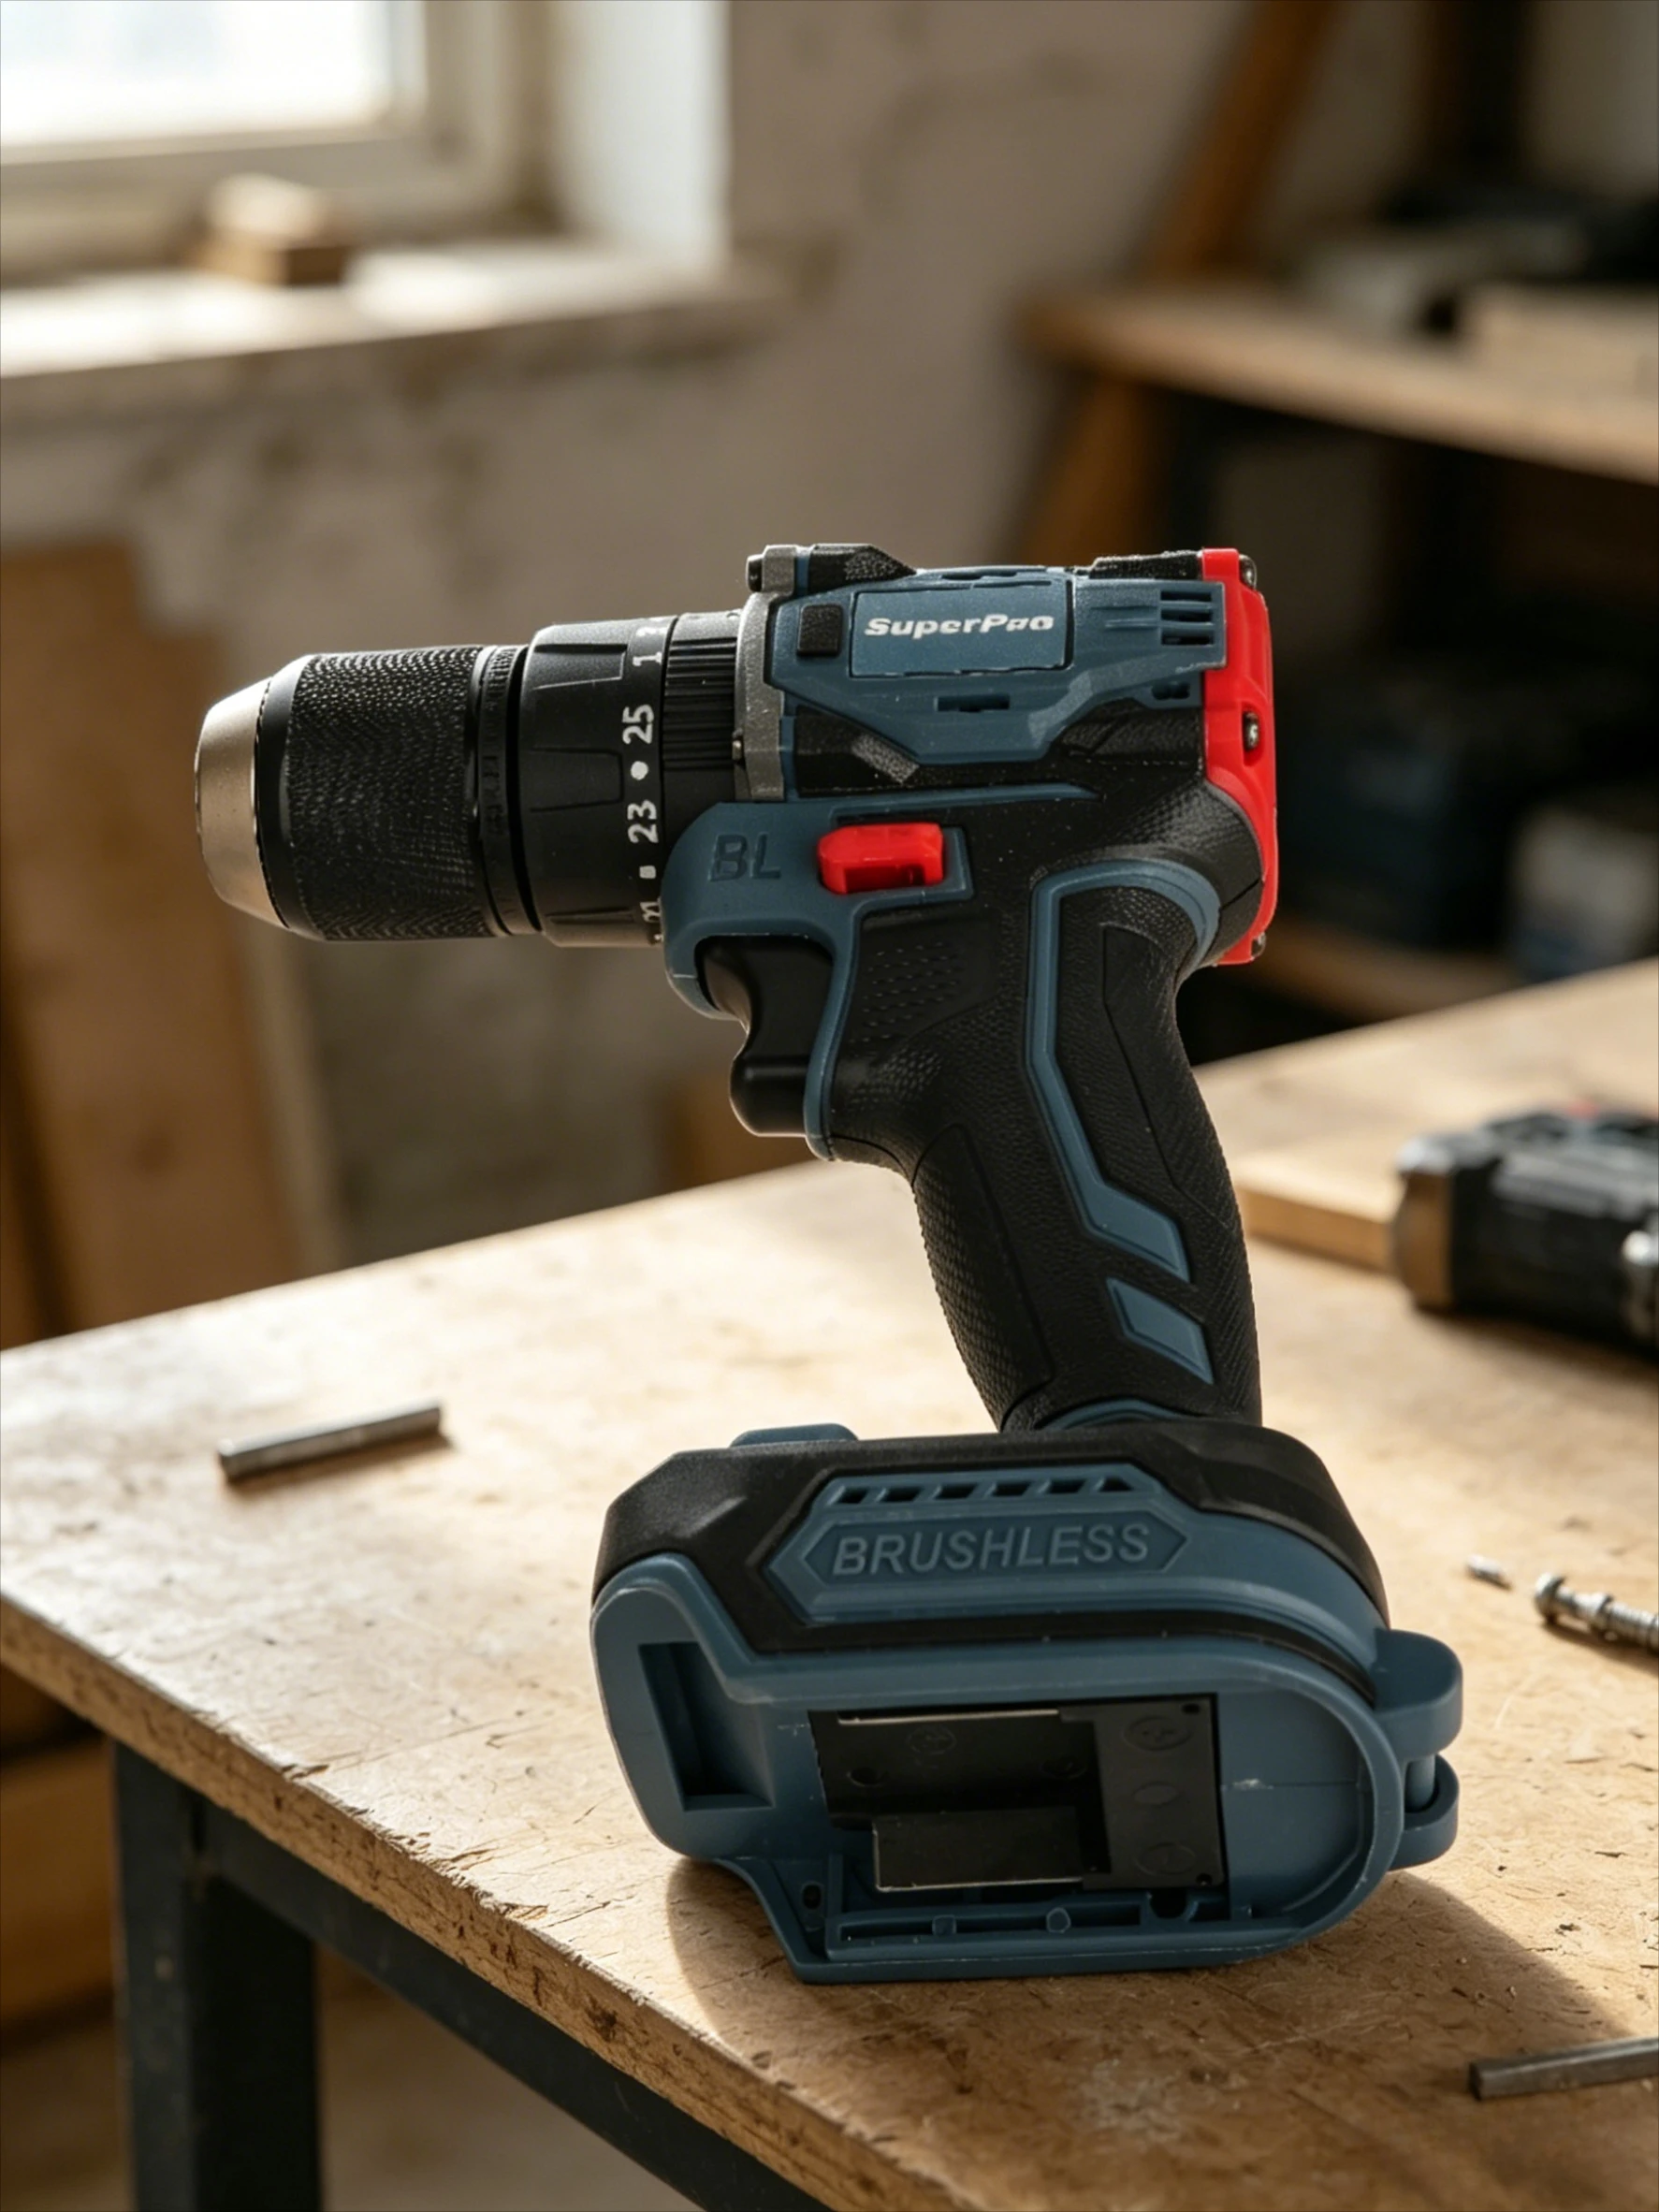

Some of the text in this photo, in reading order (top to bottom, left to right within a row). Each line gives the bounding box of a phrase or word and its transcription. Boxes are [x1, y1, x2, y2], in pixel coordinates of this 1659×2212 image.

[622, 705, 654, 744] 25
[627, 800, 659, 843] 23
[708, 833, 782, 881] BL
[832, 1522, 1150, 1576] BRUSHLESS
